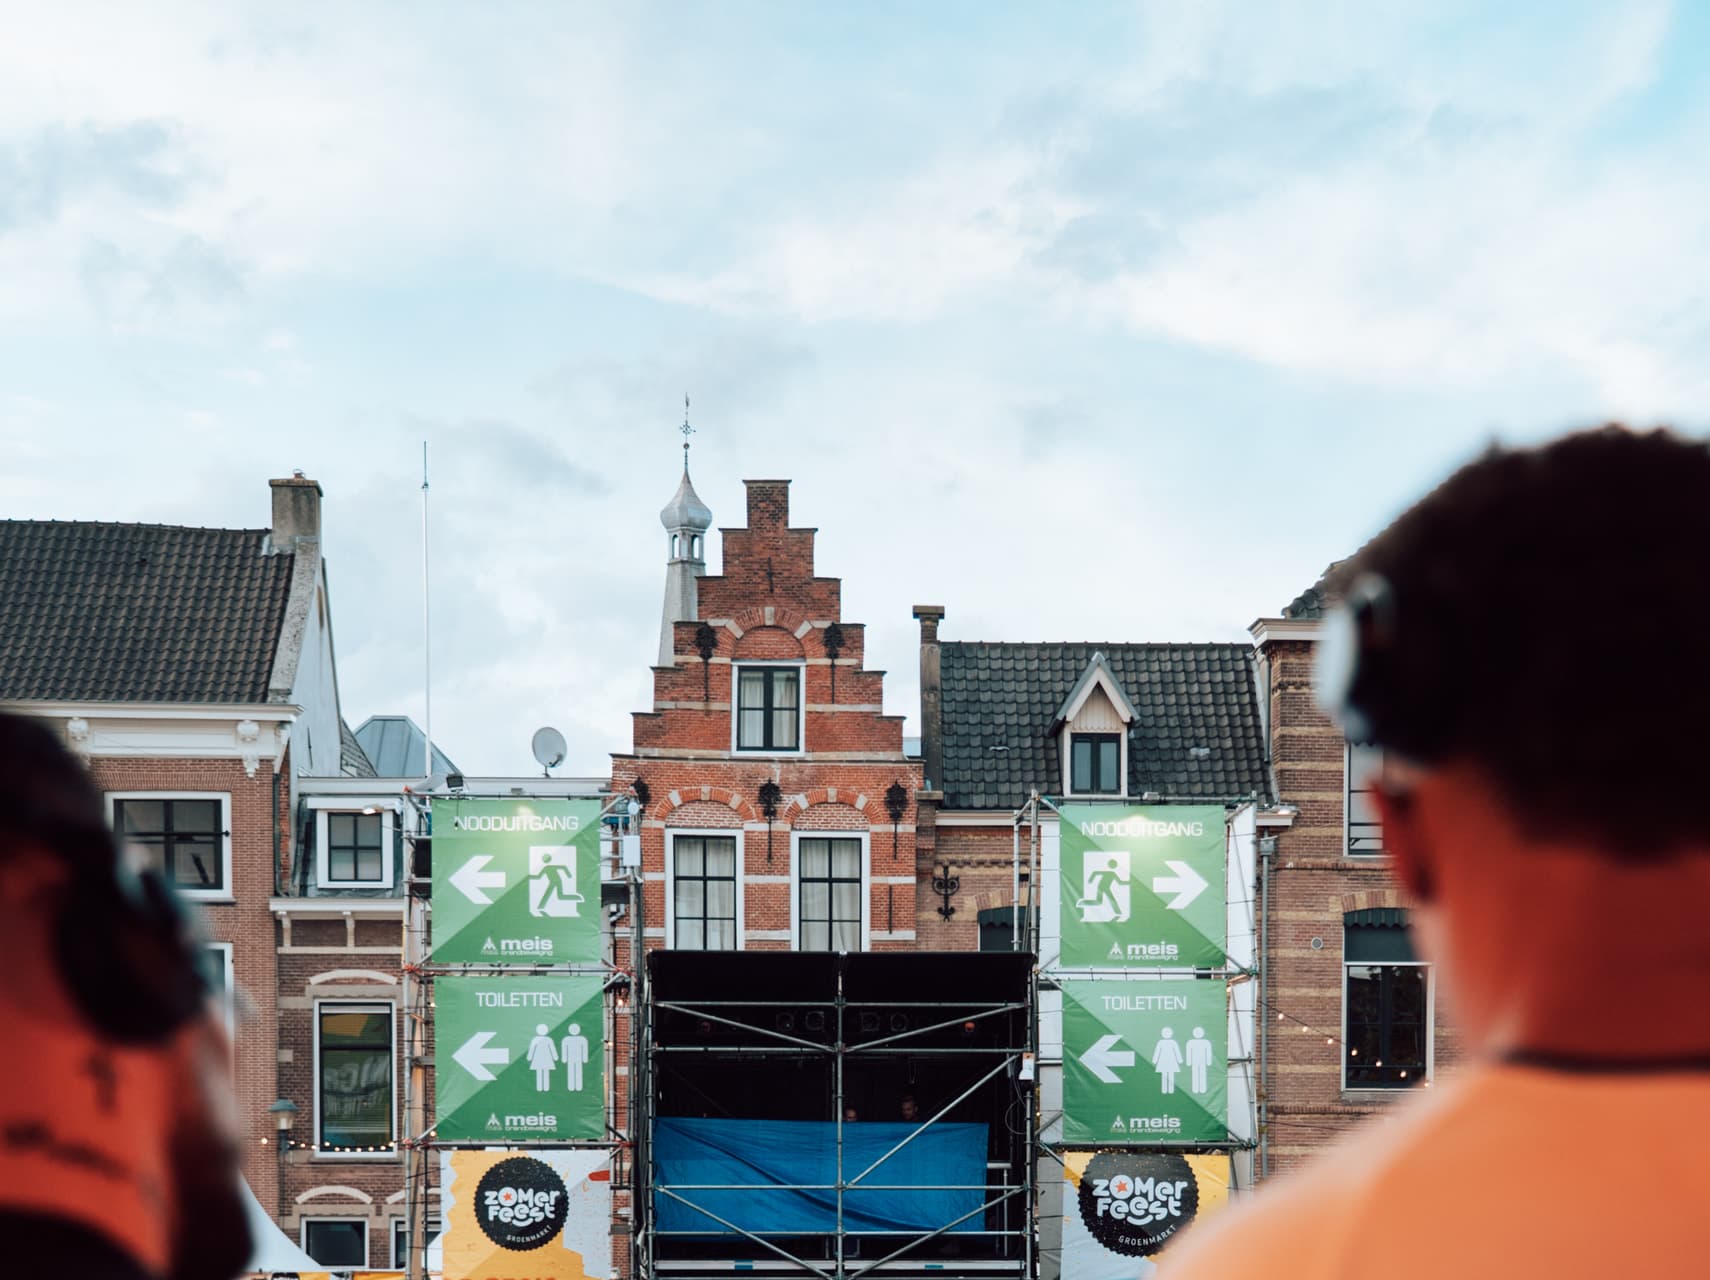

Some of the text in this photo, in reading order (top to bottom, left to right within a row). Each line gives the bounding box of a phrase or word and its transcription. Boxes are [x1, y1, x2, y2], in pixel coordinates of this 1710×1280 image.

[454, 815, 579, 831] NOODUITGANG
[1081, 821, 1204, 837] NOODUITGANG
[501, 936, 553, 950] meis
[1127, 940, 1178, 955] meis
[475, 991, 563, 1007] TOILETTEN
[1101, 994, 1187, 1010] TOILETTEN
[505, 1112, 558, 1126] meis
[1129, 1114, 1181, 1128] meis
[1118, 1224, 1177, 1246] GROENMARKT
